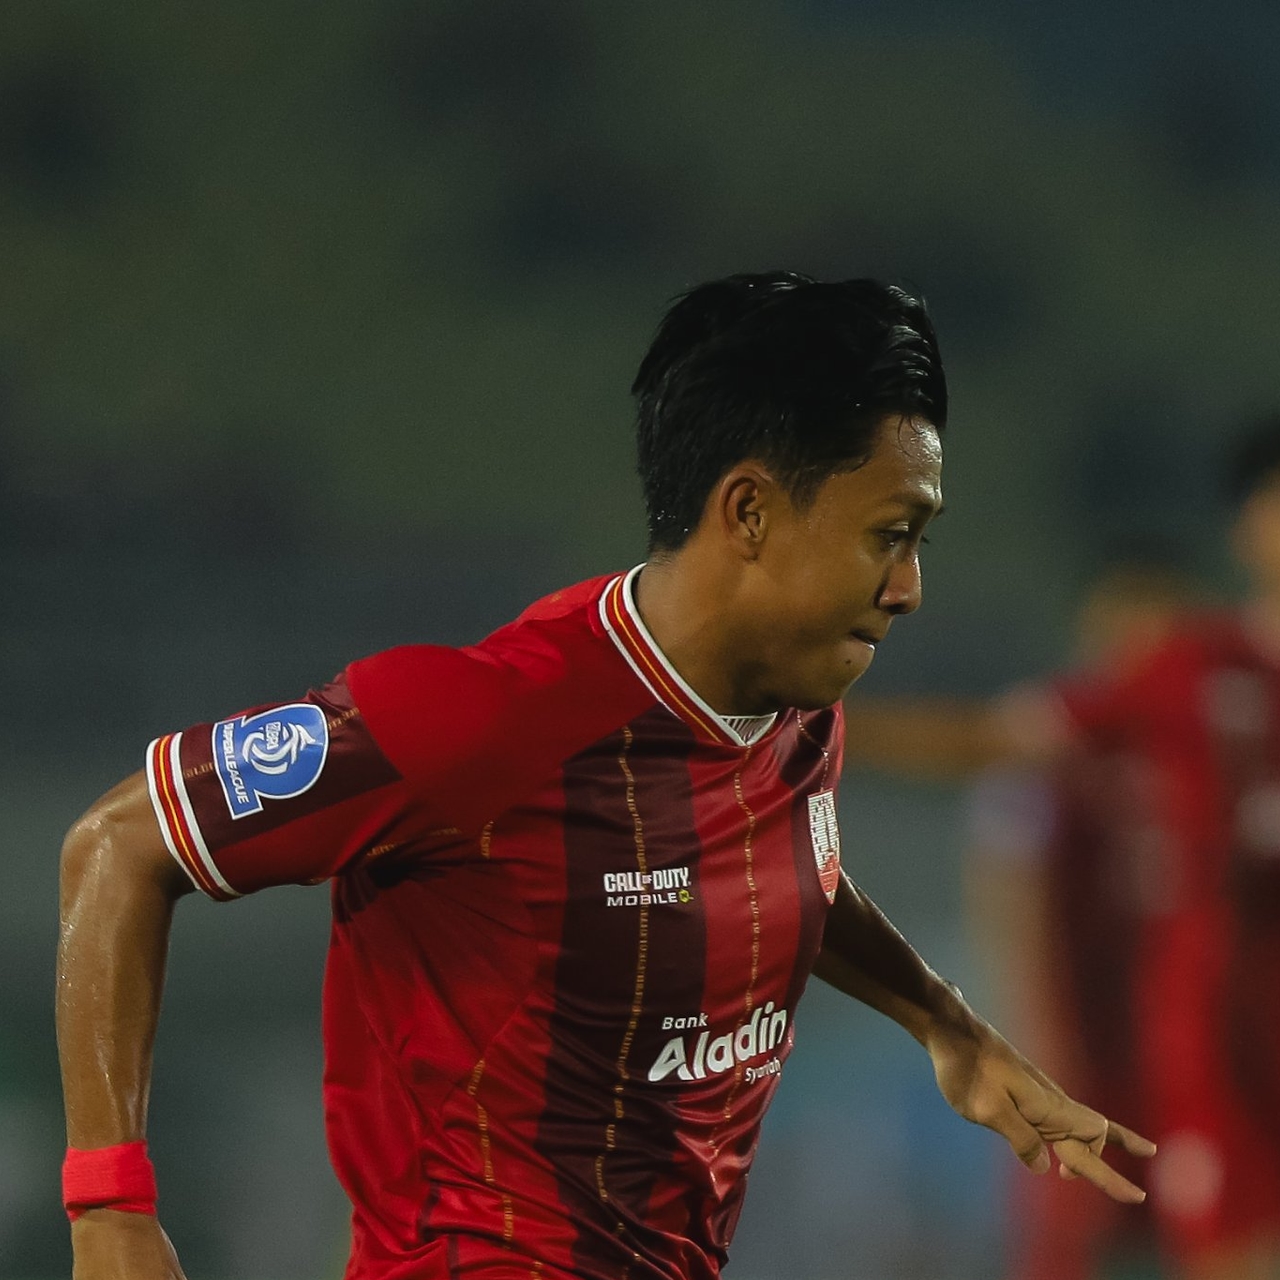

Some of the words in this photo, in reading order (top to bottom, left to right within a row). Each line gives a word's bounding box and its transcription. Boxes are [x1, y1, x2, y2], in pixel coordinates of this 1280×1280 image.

[225, 755, 249, 804] LEAGUE
[603, 872, 645, 893] CALL
[652, 866, 689, 890] DUTY
[606, 892, 678, 907] MOBILE
[662, 1012, 709, 1030] Bank
[647, 1001, 787, 1082] Aladin
